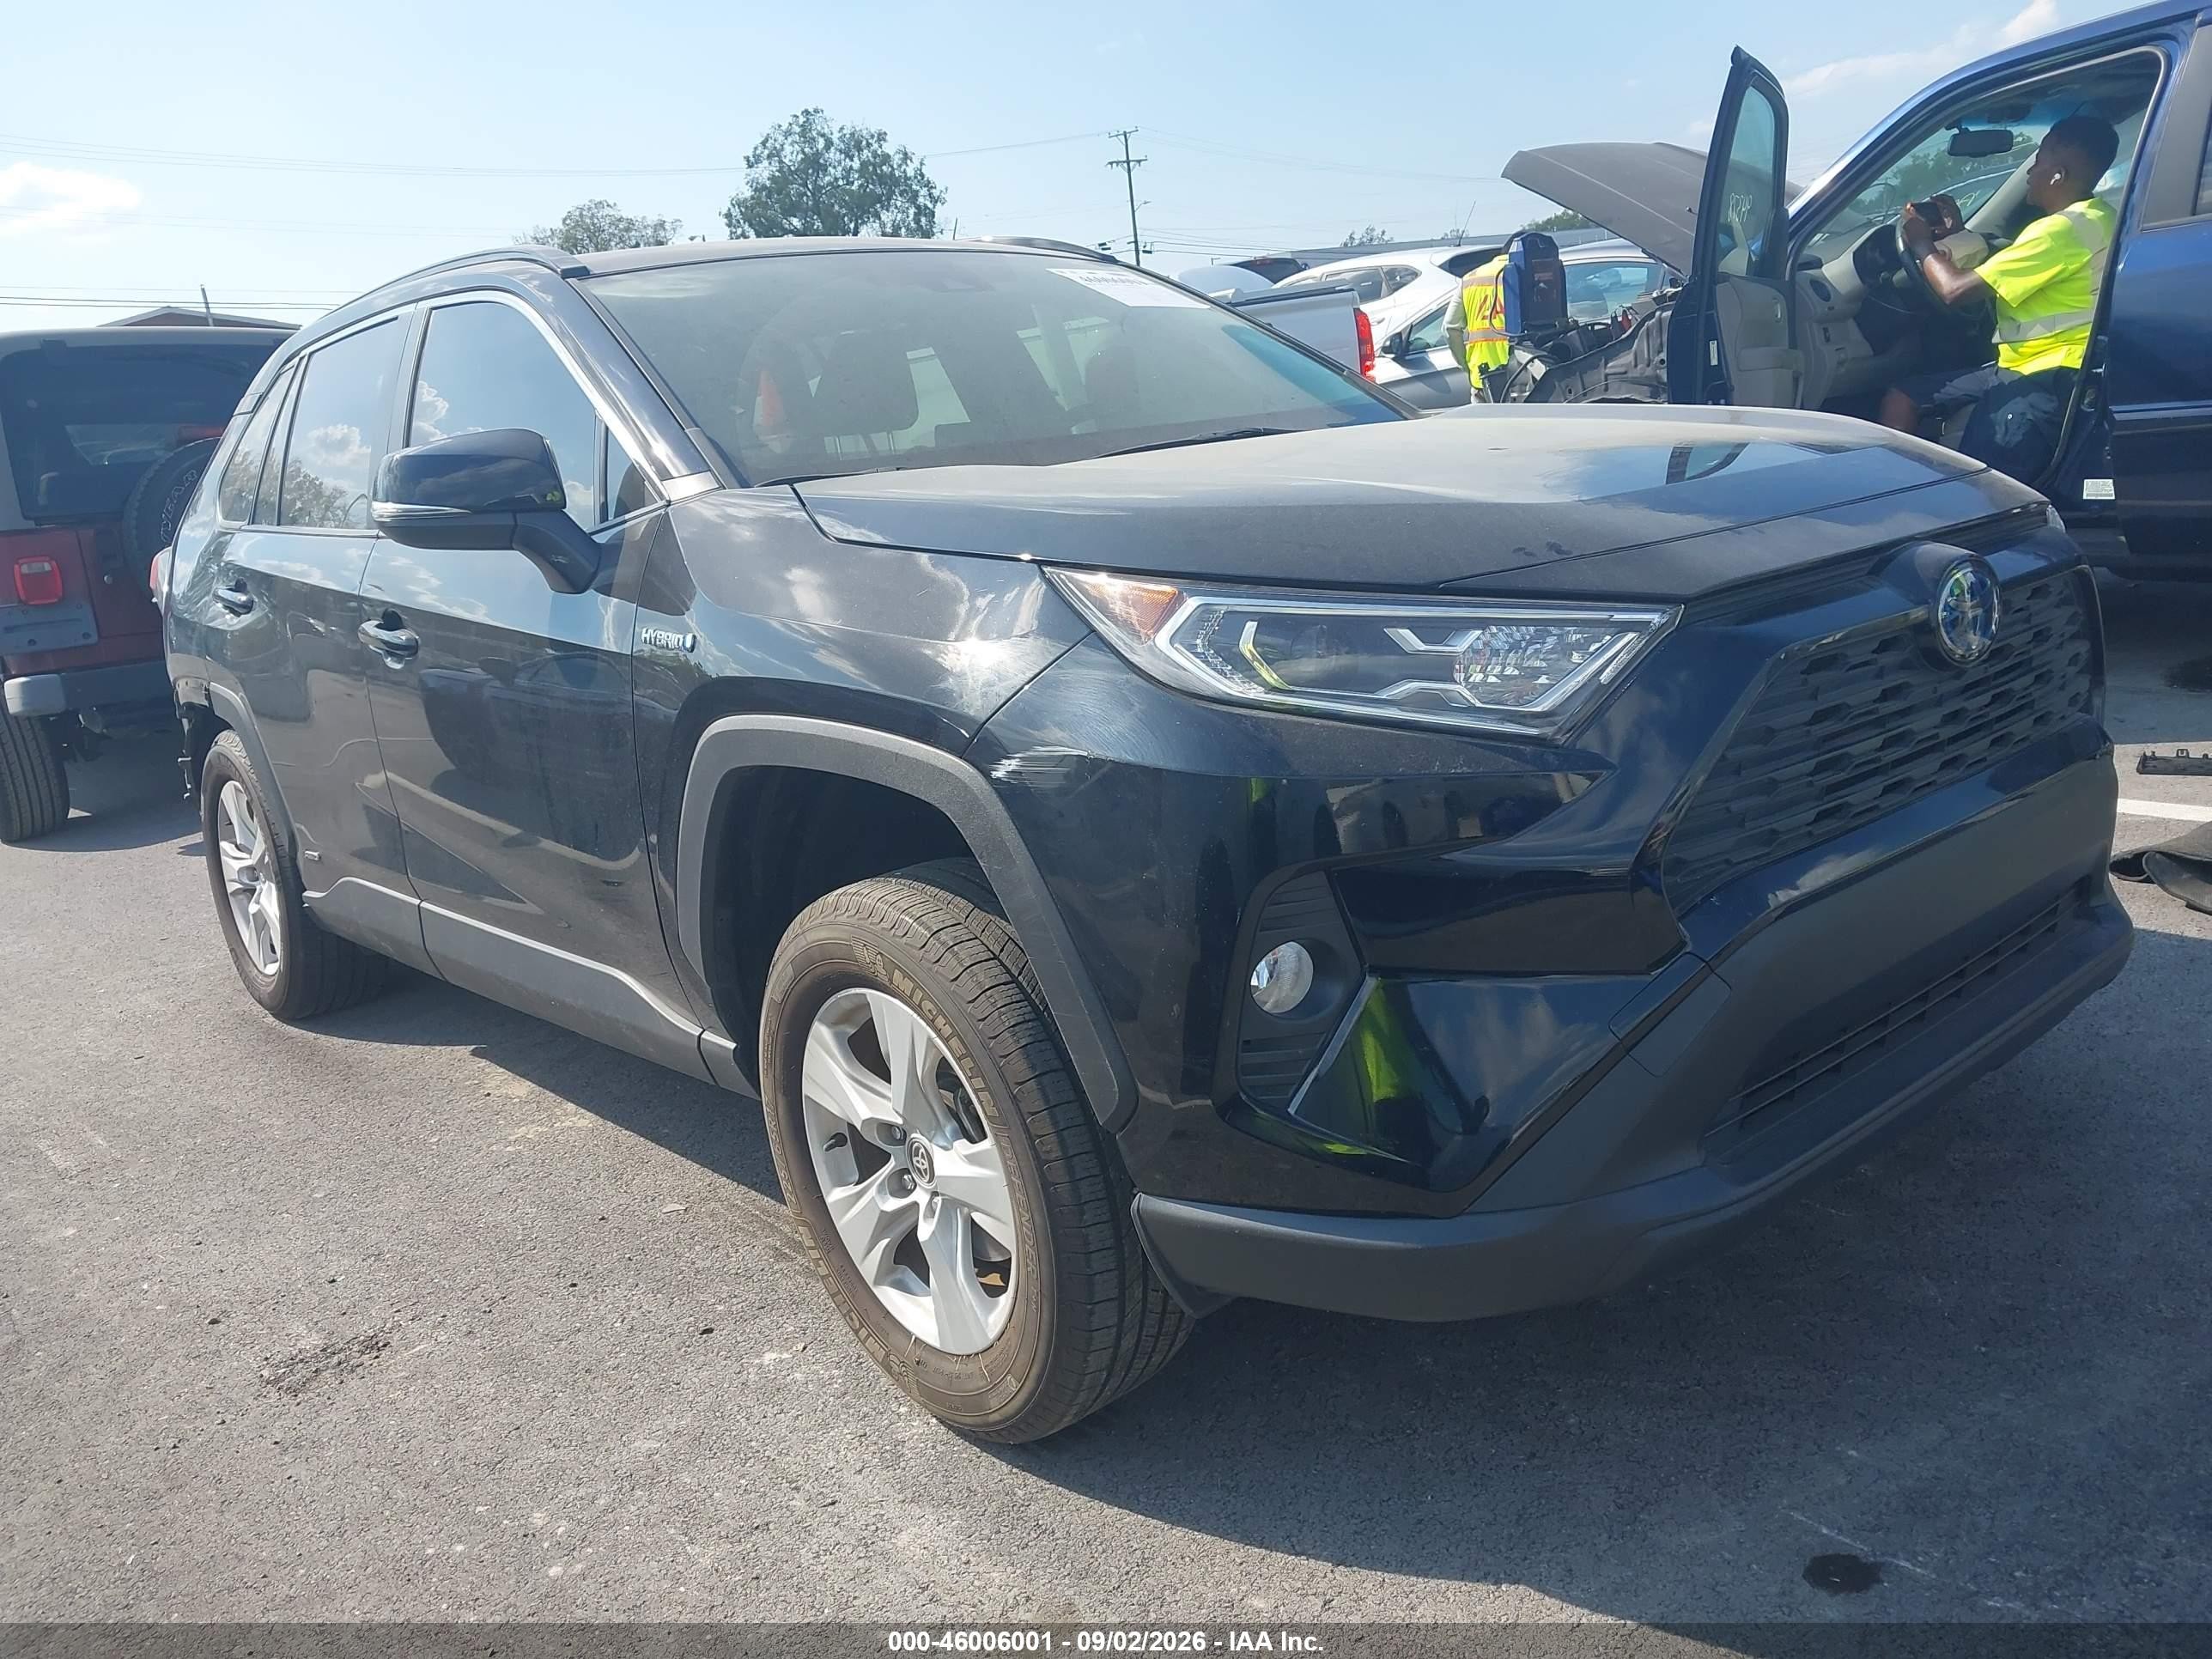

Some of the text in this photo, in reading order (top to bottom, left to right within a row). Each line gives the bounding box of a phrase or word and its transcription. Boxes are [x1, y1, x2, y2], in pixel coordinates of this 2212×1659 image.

[641, 628, 684, 648] HYBRID
[891, 968, 1000, 1117] MICHELIN
[1000, 1140, 1039, 1273] DEFENDER
